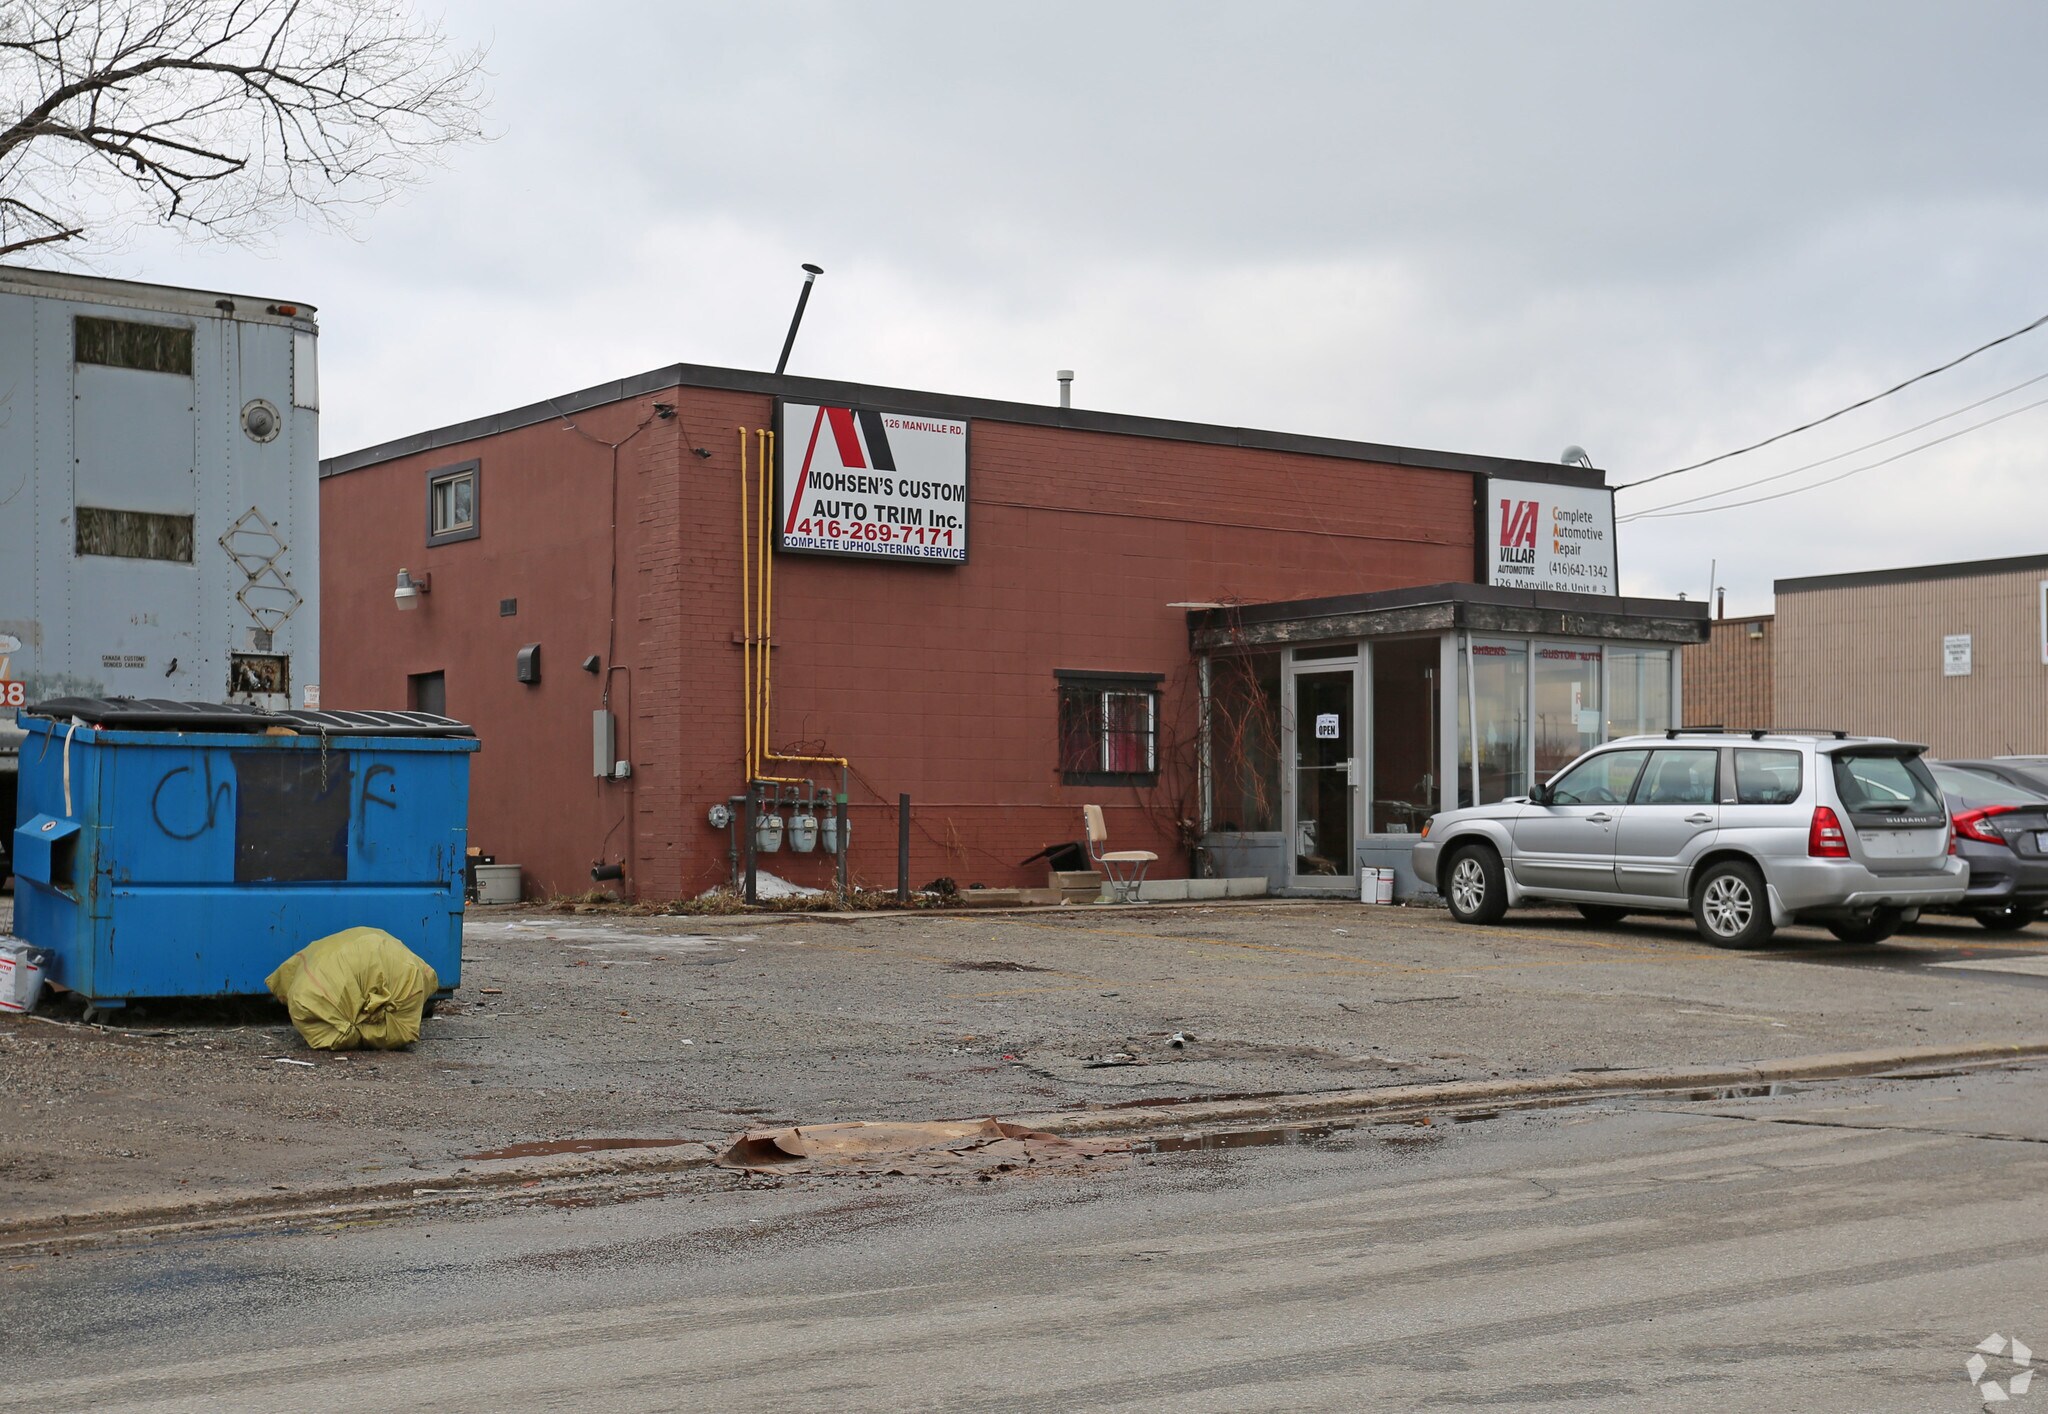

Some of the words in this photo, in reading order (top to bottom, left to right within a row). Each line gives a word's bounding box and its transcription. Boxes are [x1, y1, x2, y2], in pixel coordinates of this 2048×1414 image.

[884, 419, 900, 429] 126
[902, 420, 947, 434] MANVILLE
[950, 426, 964, 436] RD.
[809, 471, 893, 496] MOHSEN'S
[899, 479, 965, 502] CUSTOM
[813, 499, 867, 521] AUTO
[874, 504, 922, 526] TRIM
[929, 509, 963, 529] Inc.
[1552, 506, 1593, 524] Complete
[798, 518, 953, 547] 416-269-7171
[1553, 523, 1603, 541] Automotive
[784, 536, 839, 550] COMPLETE
[842, 540, 920, 556] UPHOLSTERING
[923, 546, 966, 559] SERVICE
[1500, 547, 1535, 564] VILLAR
[1553, 539, 1581, 557] Repair
[1497, 564, 1535, 576] AUTOMOTIVE
[1549, 561, 1608, 578] (416)642-1342
[1495, 578, 1511, 588] 126
[1515, 579, 1553, 591] Manville
[1556, 581, 1570, 592] Rd.
[1571, 582, 1590, 593] Unit
[1601, 585, 1607, 593] 3
[1318, 725, 1336, 736] OPEN
